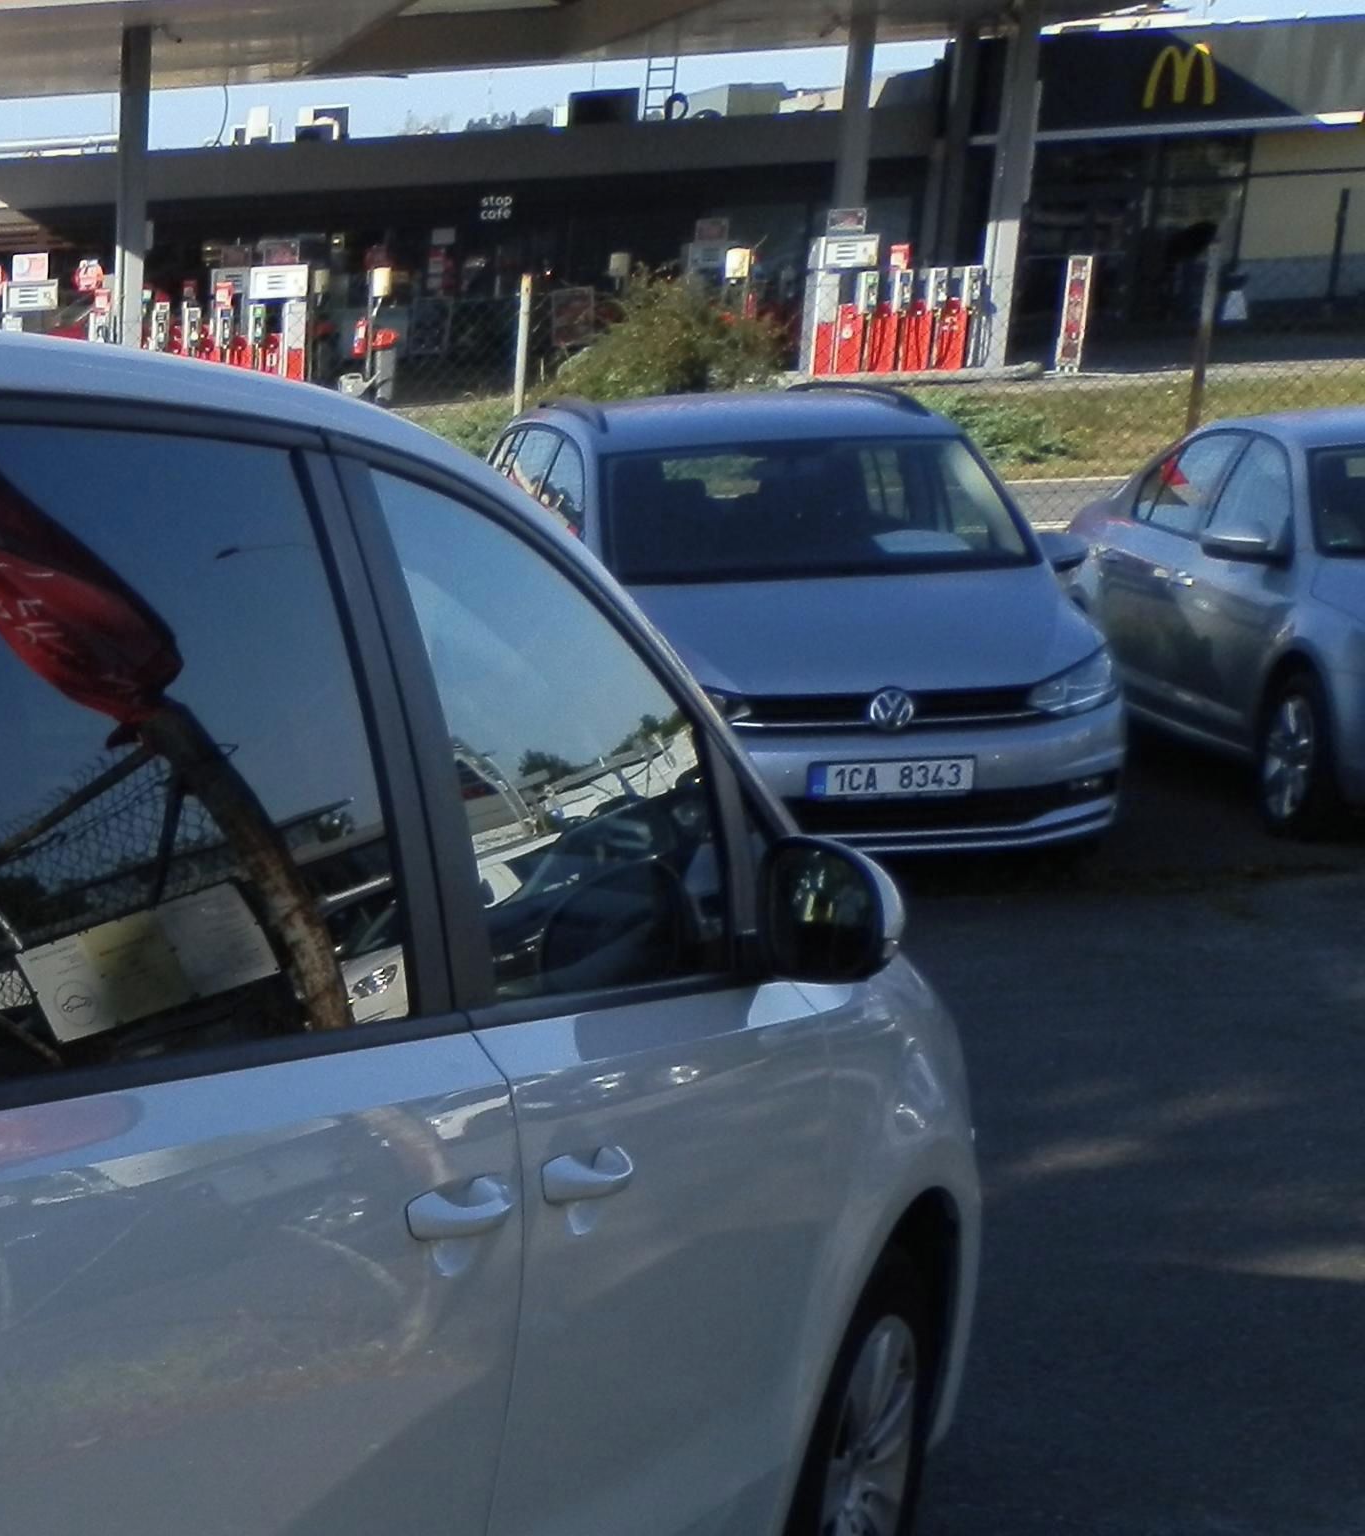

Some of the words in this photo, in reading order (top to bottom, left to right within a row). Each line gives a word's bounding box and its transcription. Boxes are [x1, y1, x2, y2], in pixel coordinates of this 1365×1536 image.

[480, 195, 513, 208] stop
[834, 767, 877, 792] 1CA
[899, 763, 962, 790] 8343
